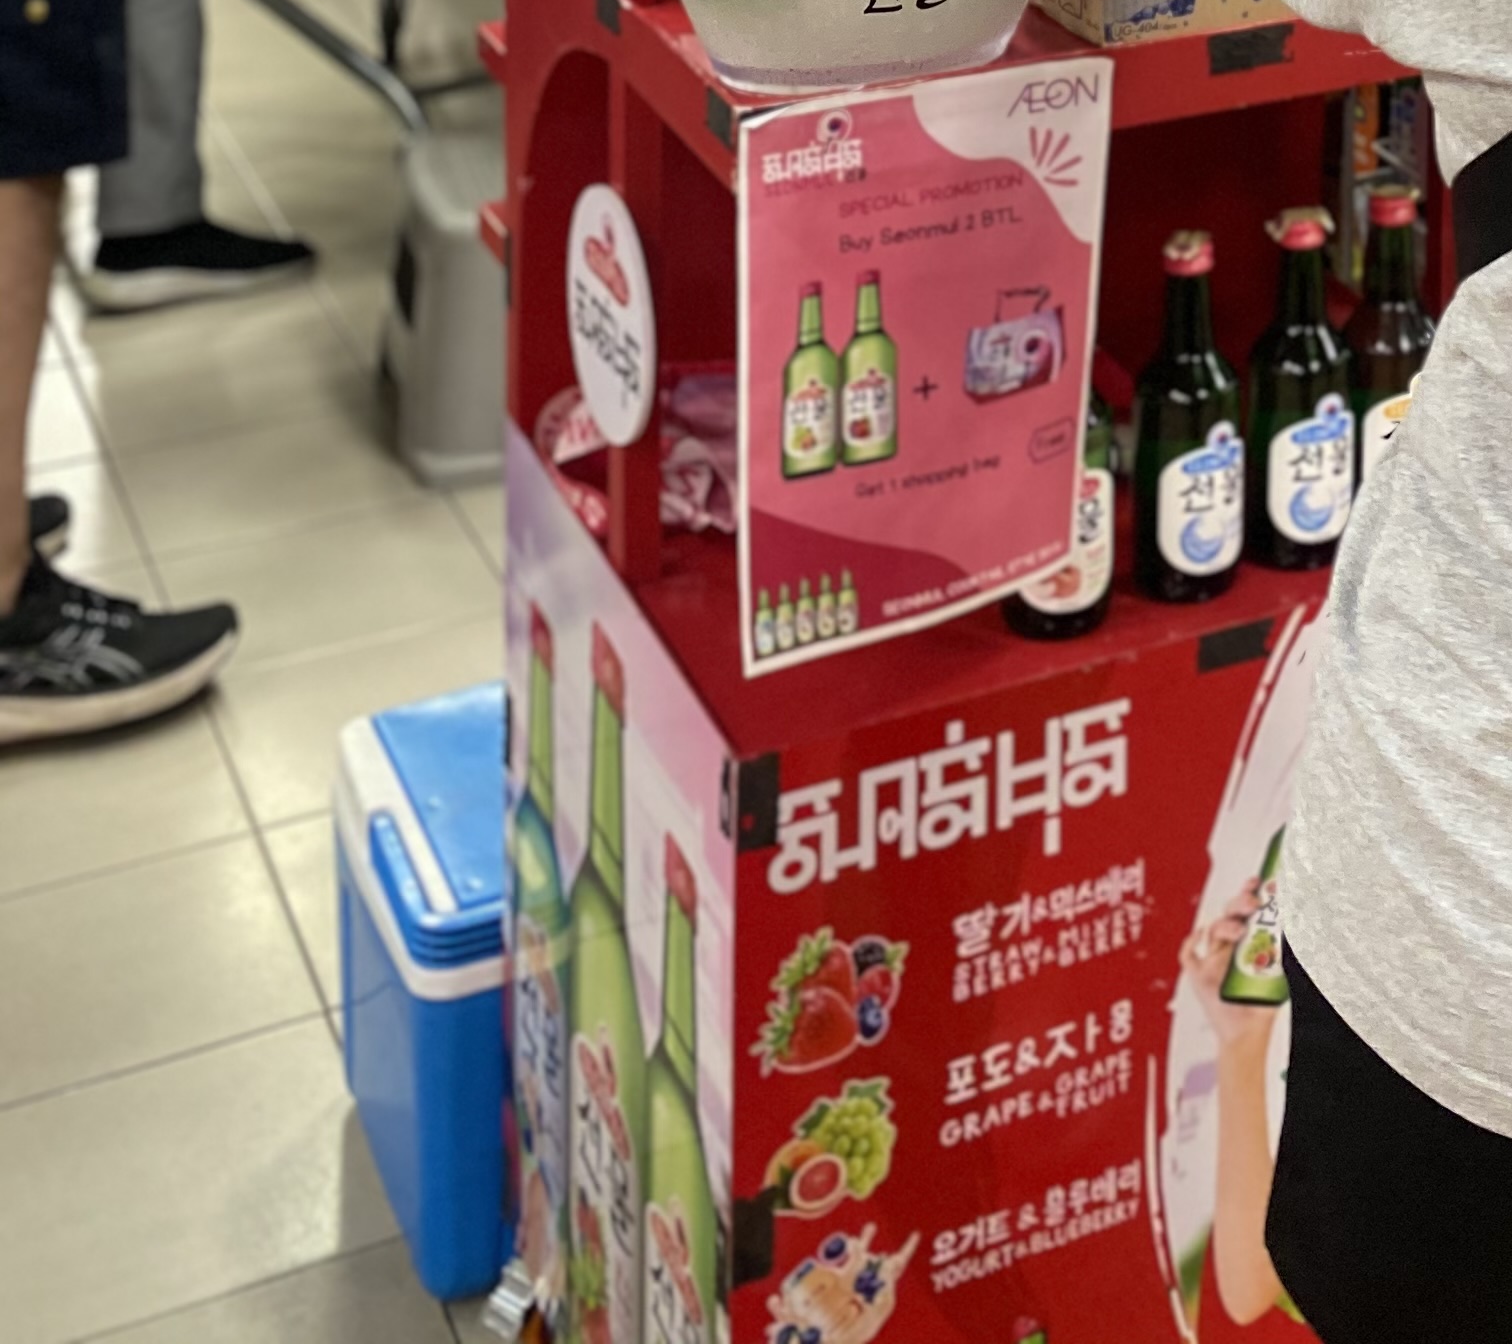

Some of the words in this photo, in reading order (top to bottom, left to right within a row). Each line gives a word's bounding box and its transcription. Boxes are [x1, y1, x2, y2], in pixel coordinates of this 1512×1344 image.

[839, 192, 912, 219] SPECIAL
[919, 172, 1024, 204] PROMOTION
[839, 233, 872, 254] Buy
[879, 219, 959, 246] Seonmul
[966, 215, 976, 231] 2
[982, 205, 1023, 228] BTL
[902, 462, 968, 490] shopping
[938, 1091, 1033, 1147] GRAPE
[1055, 1048, 1132, 1096] GRAPE
[1056, 1070, 1130, 1119] FRUIT
